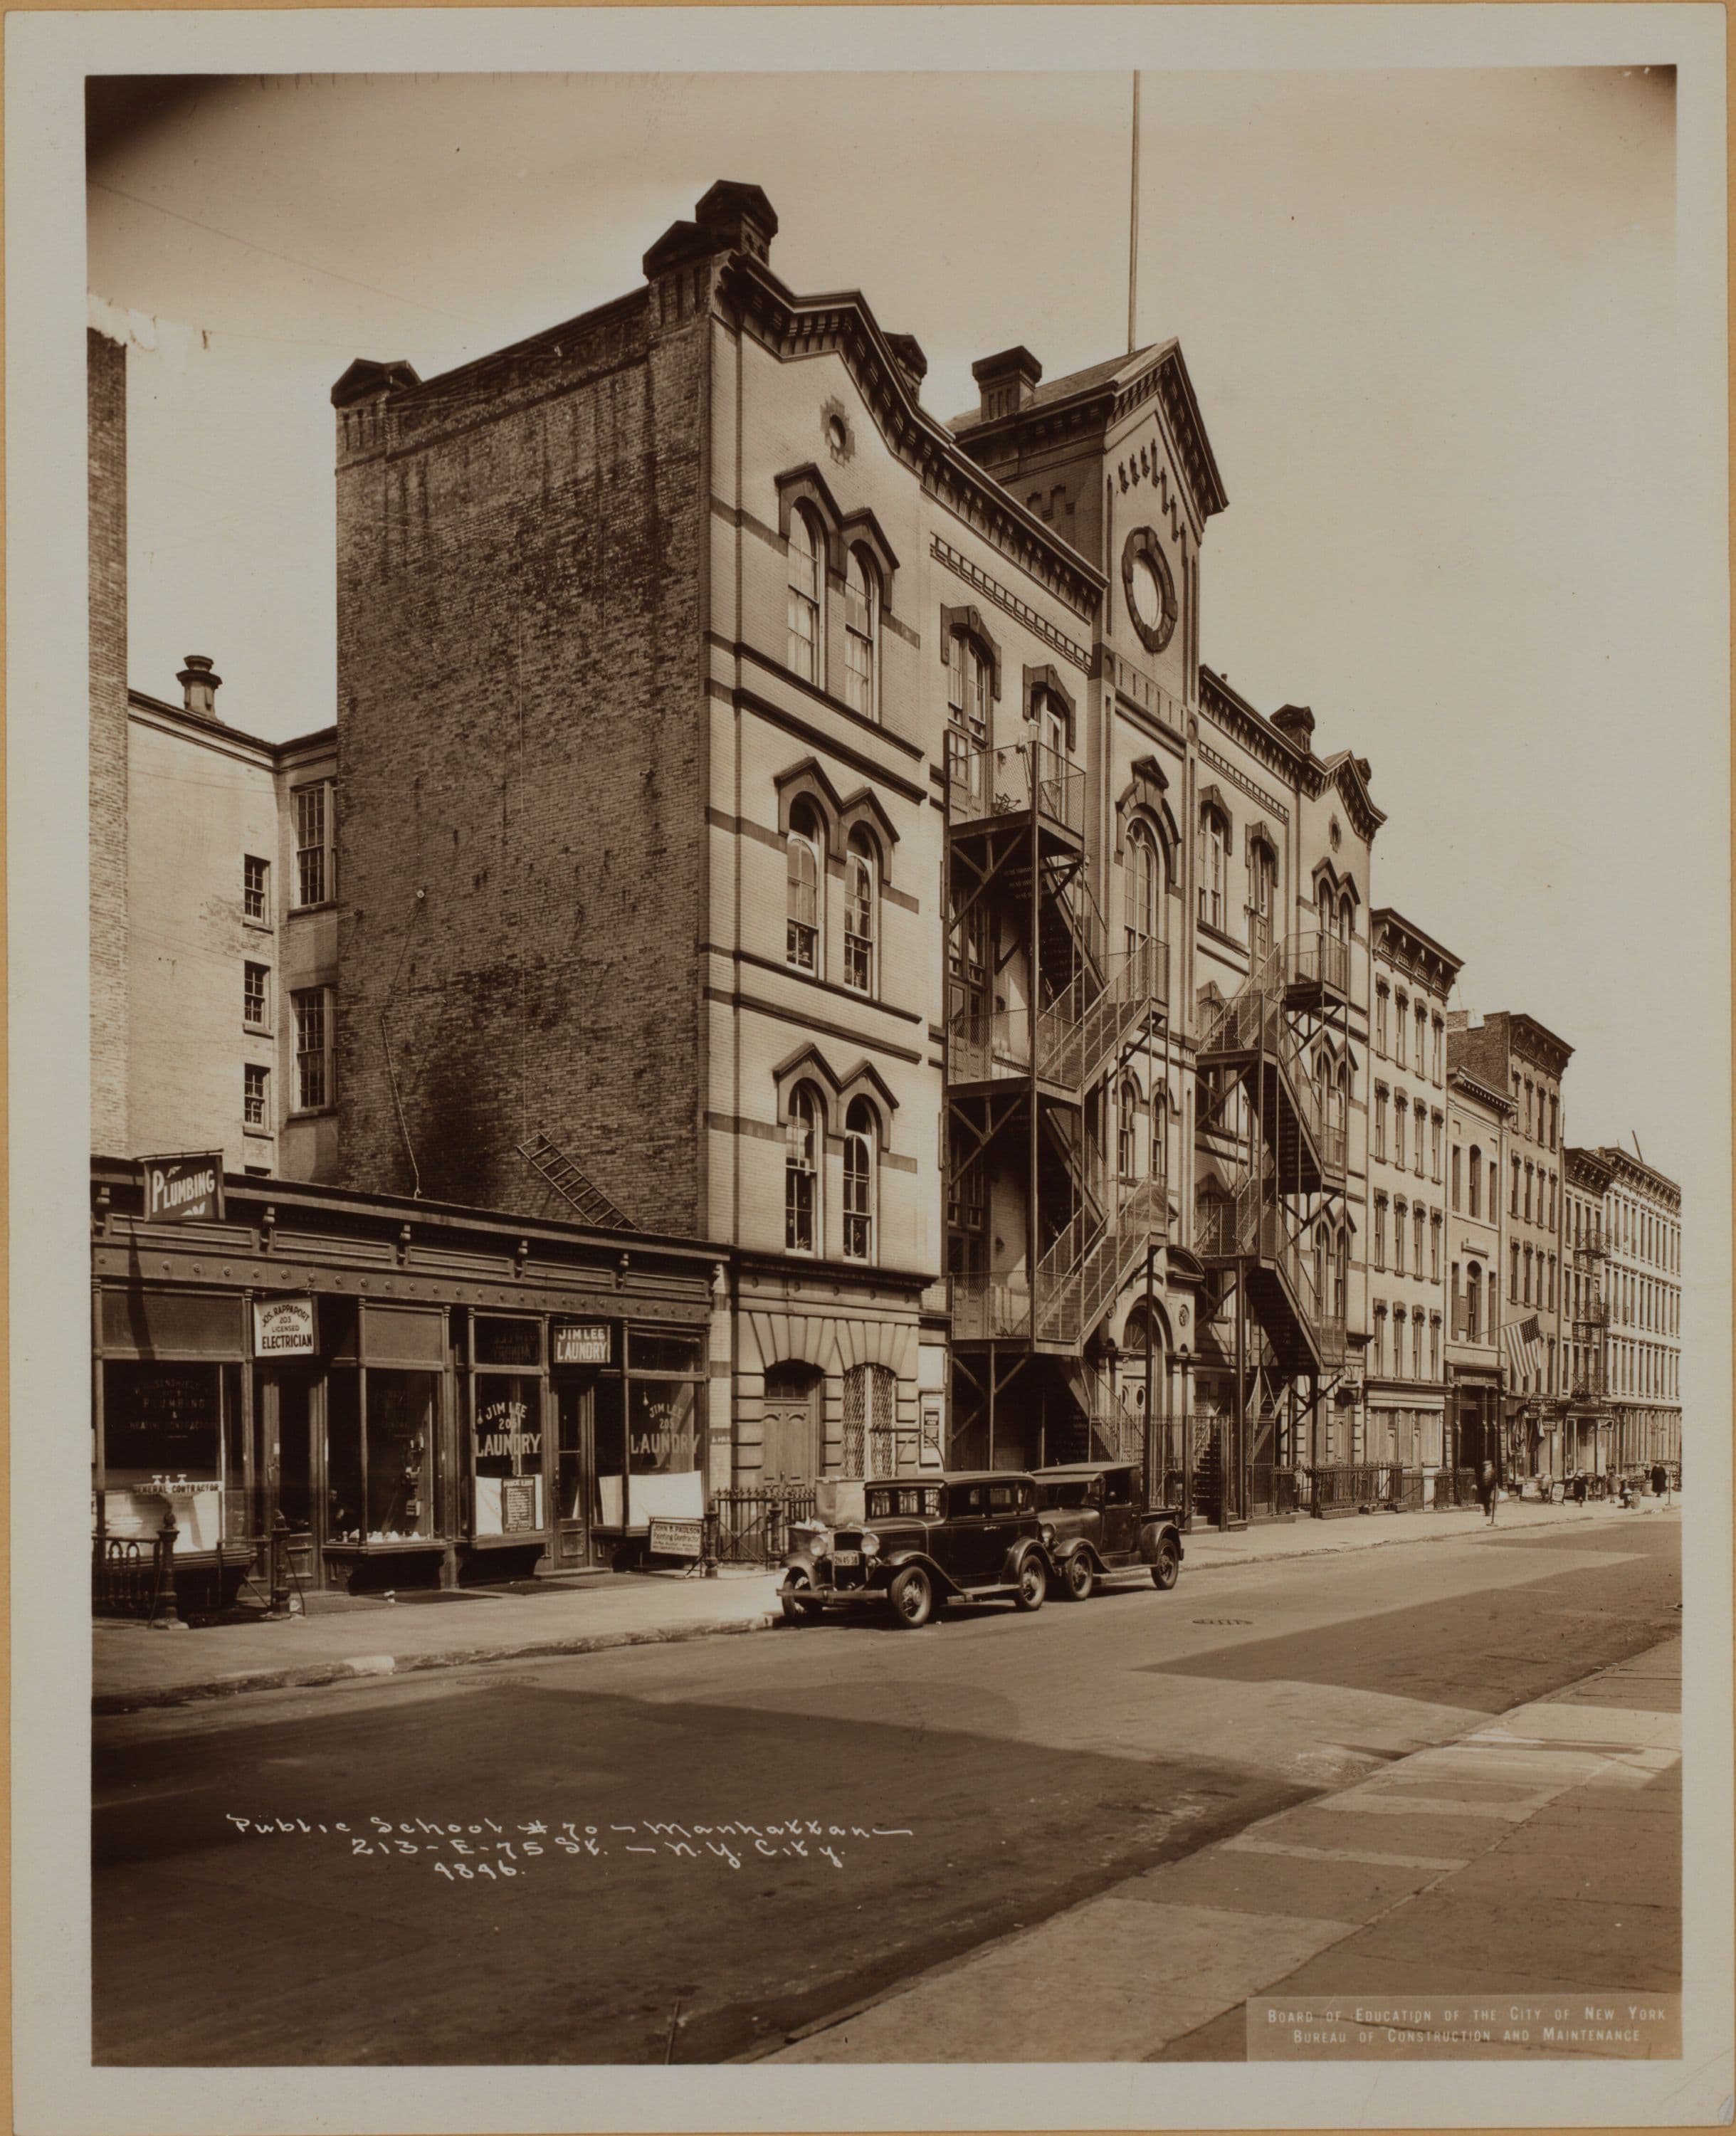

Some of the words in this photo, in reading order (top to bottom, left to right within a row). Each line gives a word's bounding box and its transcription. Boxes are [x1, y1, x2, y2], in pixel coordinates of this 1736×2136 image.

[152, 1169, 216, 1214] PLUMBING
[273, 1304, 310, 1322] RAPPAPORT
[280, 1315, 292, 1324] 203
[262, 1334, 312, 1349] ELECTRICIAN
[558, 1329, 582, 1340] JIM
[584, 1328, 605, 1340] LEE
[557, 1342, 607, 1361] LAUNDRY
[485, 1401, 505, 1420] JIM
[508, 1401, 527, 1418] LEE
[649, 1403, 665, 1418] JIM
[667, 1404, 685, 1419] LEE
[498, 1417, 517, 1430] 205
[659, 1419, 674, 1429] 205
[475, 1433, 542, 1457] LAUNDRY
[630, 1433, 700, 1454] LAUNDRY
[172, 1483, 219, 1493] CONTRACTOR
[675, 1525, 700, 1534] PAULSON
